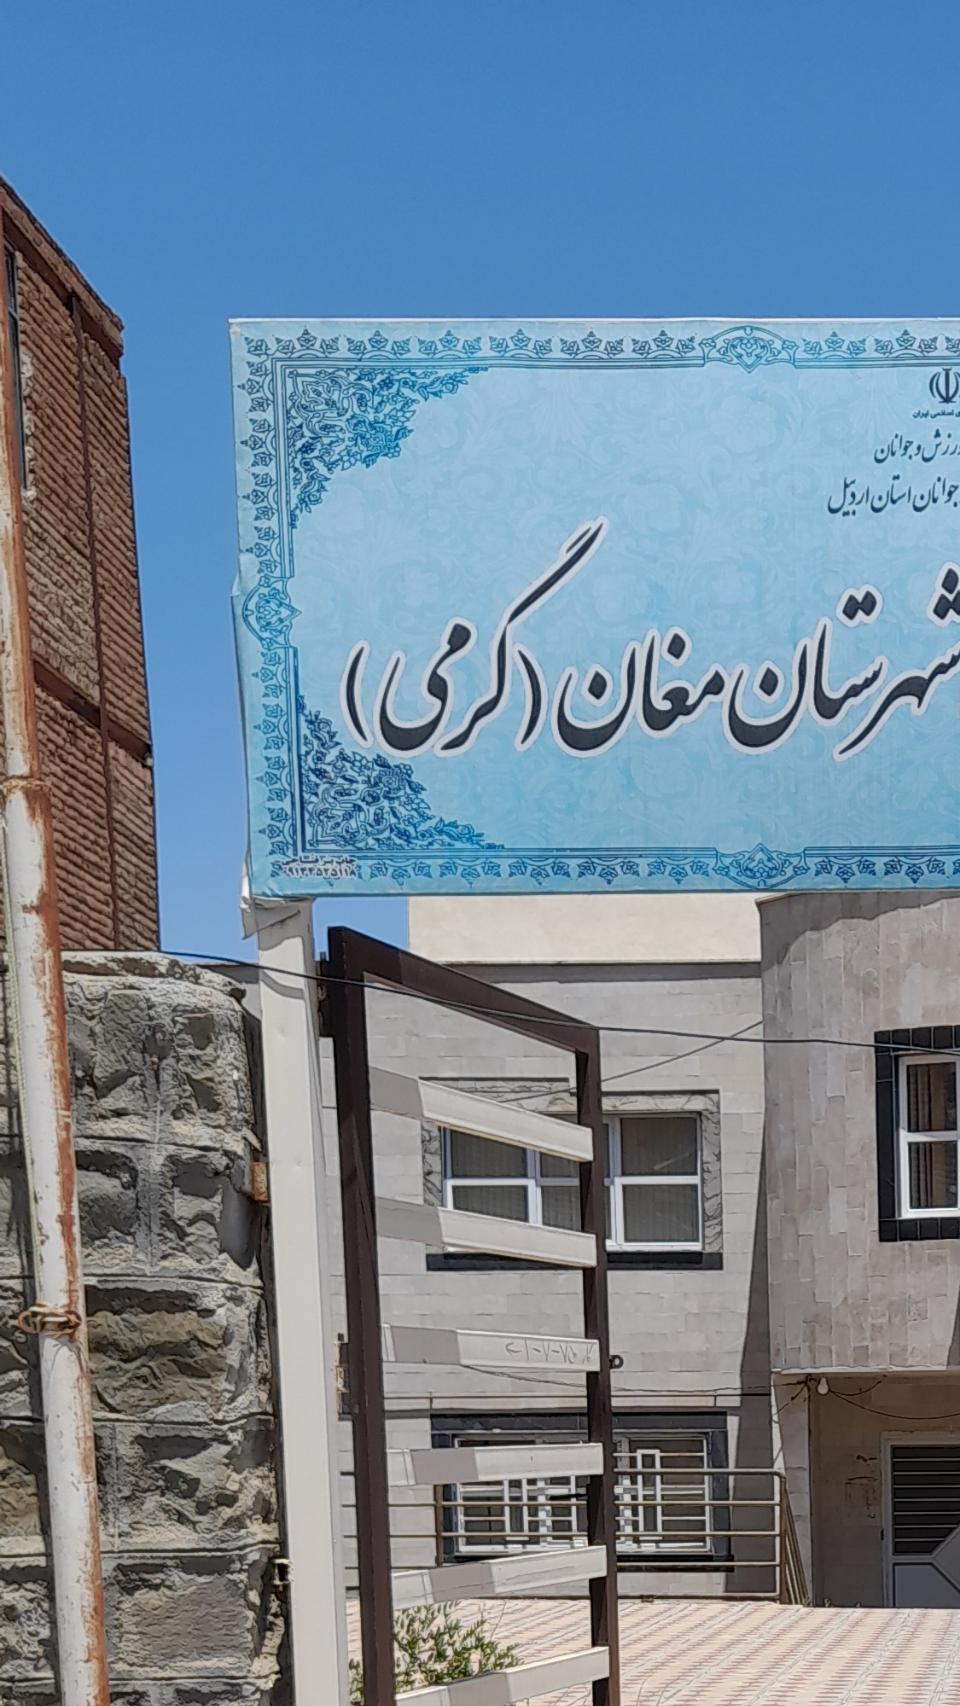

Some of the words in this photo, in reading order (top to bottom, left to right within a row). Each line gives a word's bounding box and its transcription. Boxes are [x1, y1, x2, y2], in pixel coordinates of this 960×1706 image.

[912, 409, 930, 419] ایران
[873, 433, 914, 464] جوانان
[827, 476, 870, 517] اردبیل
[869, 474, 912, 514] استان
[911, 475, 959, 513] جوانان
[556, 631, 726, 753] مغان
